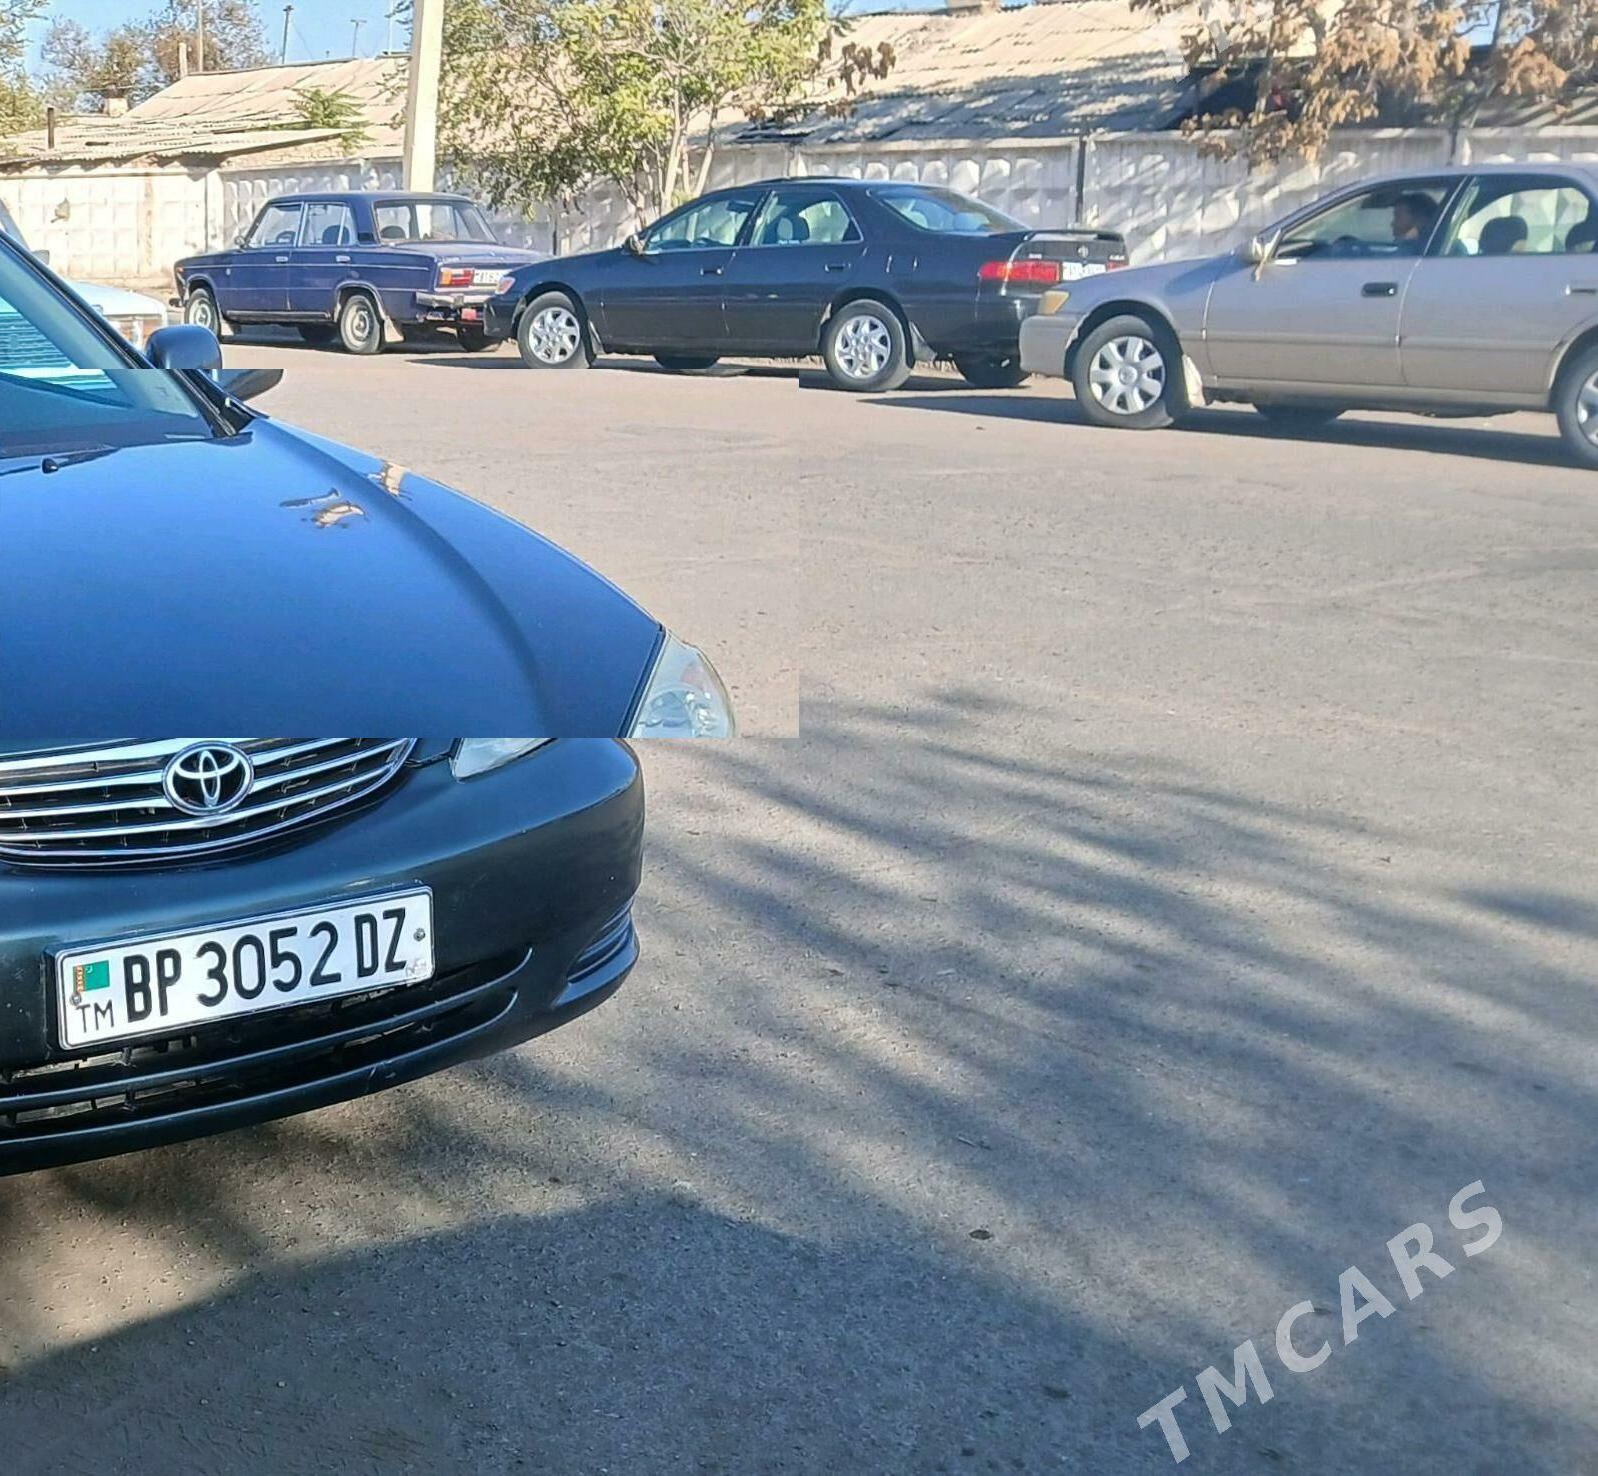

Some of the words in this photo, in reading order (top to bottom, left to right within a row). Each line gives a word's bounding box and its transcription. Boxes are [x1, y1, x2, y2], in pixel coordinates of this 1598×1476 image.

[122, 948, 182, 1023] BP
[196, 920, 342, 1008] 3052
[354, 907, 407, 979] DZ
[76, 1000, 115, 1034] TM
